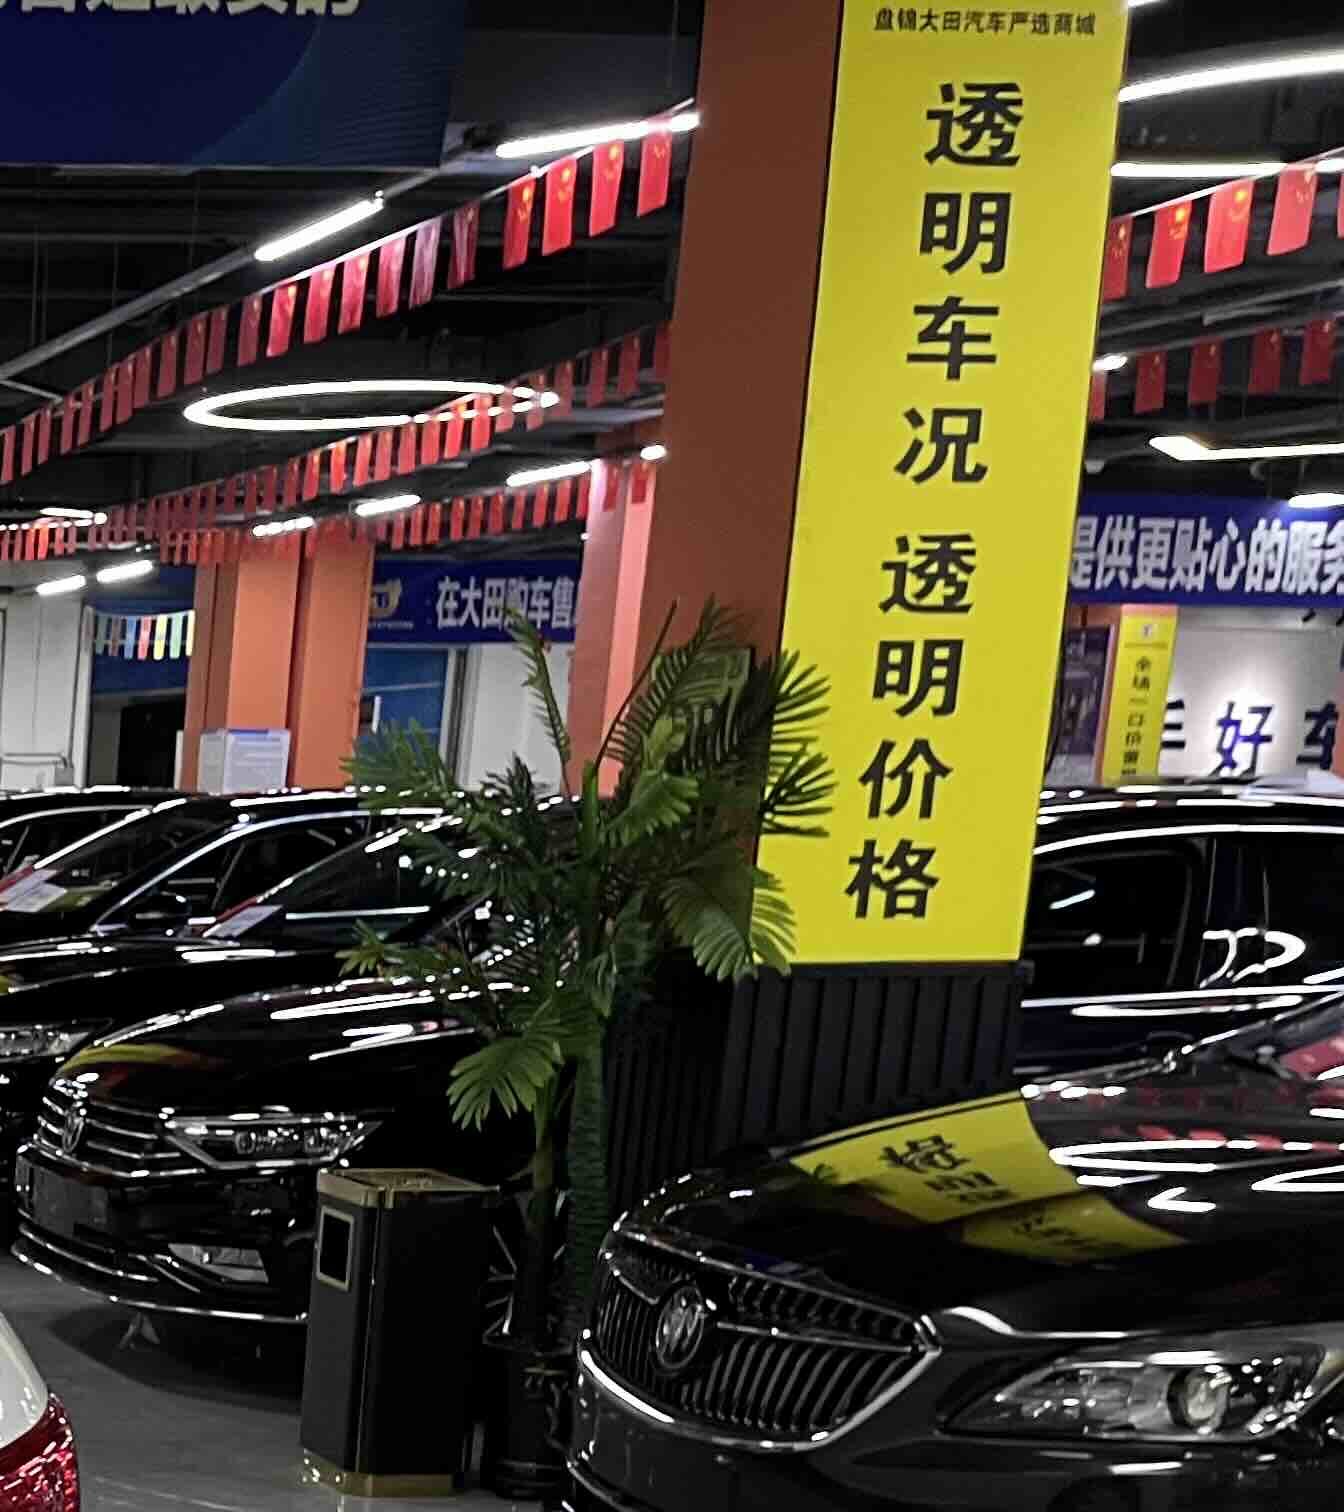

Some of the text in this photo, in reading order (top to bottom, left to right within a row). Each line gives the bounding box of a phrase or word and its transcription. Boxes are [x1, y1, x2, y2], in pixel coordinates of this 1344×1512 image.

[844, 82, 1023, 920] 透明车况 透明价格
